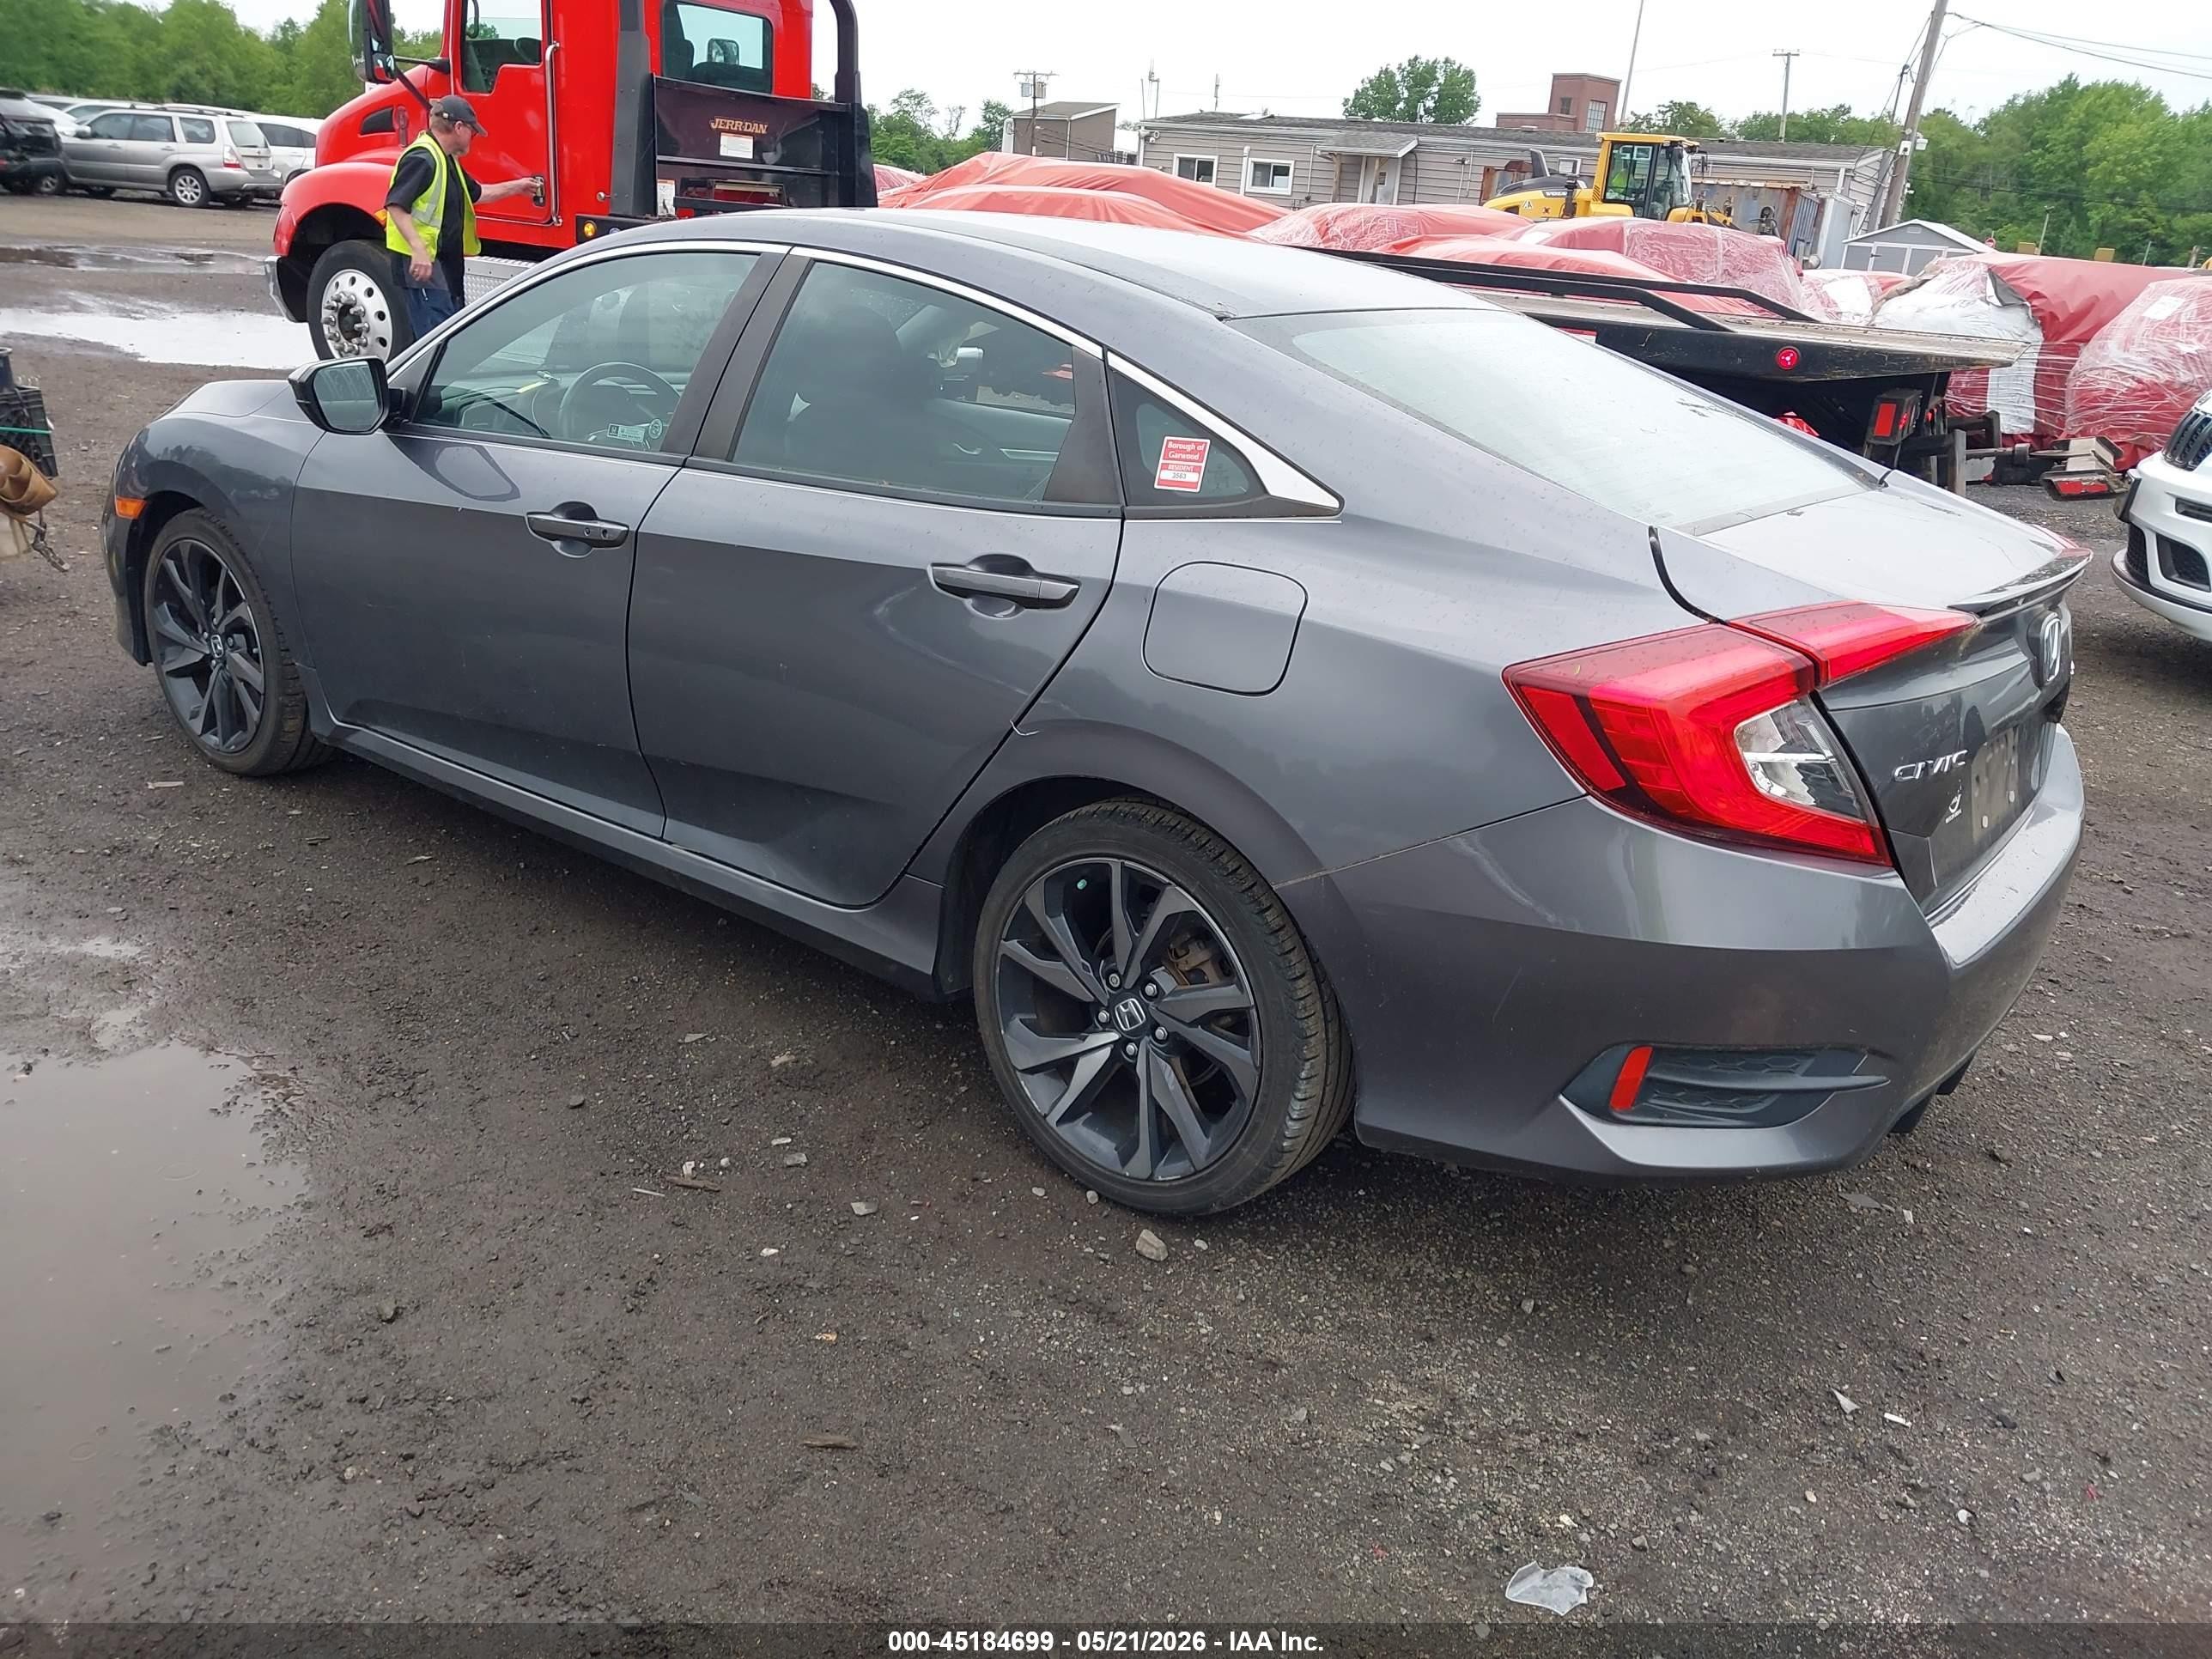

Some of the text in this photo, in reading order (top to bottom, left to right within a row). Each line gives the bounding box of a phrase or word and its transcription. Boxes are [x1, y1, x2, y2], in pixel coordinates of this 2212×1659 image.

[1168, 441, 1206, 452] Borough of
[1893, 750, 1968, 782] CIVIC
